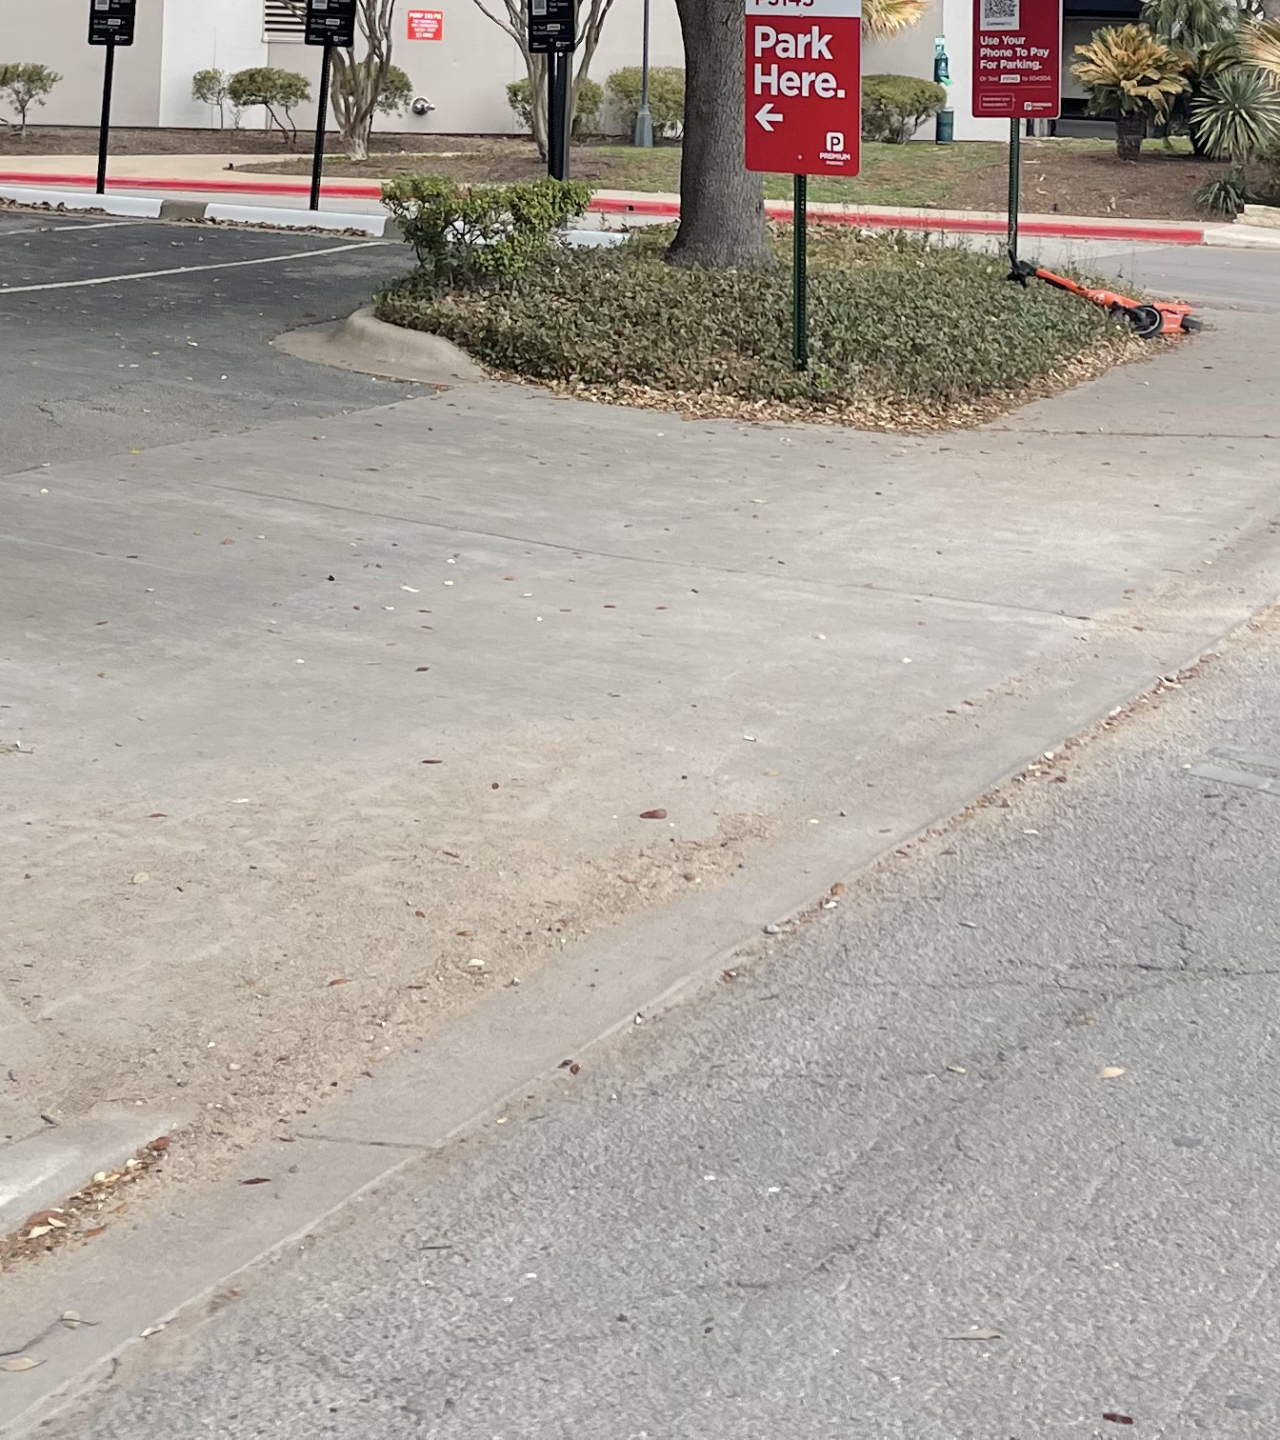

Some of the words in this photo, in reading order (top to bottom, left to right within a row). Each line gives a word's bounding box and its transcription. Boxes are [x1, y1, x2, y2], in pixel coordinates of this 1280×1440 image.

[754, 25, 834, 60] Park
[979, 36, 1000, 46] Use
[1002, 35, 1026, 46] Your
[980, 47, 1014, 58] Phone
[1015, 47, 1028, 57] To
[1030, 47, 1050, 59] Pay
[980, 60, 998, 70] For
[1000, 59, 1042, 71] Parking.
[754, 63, 846, 98] Here.
[819, 152, 851, 161] PREMIUM
